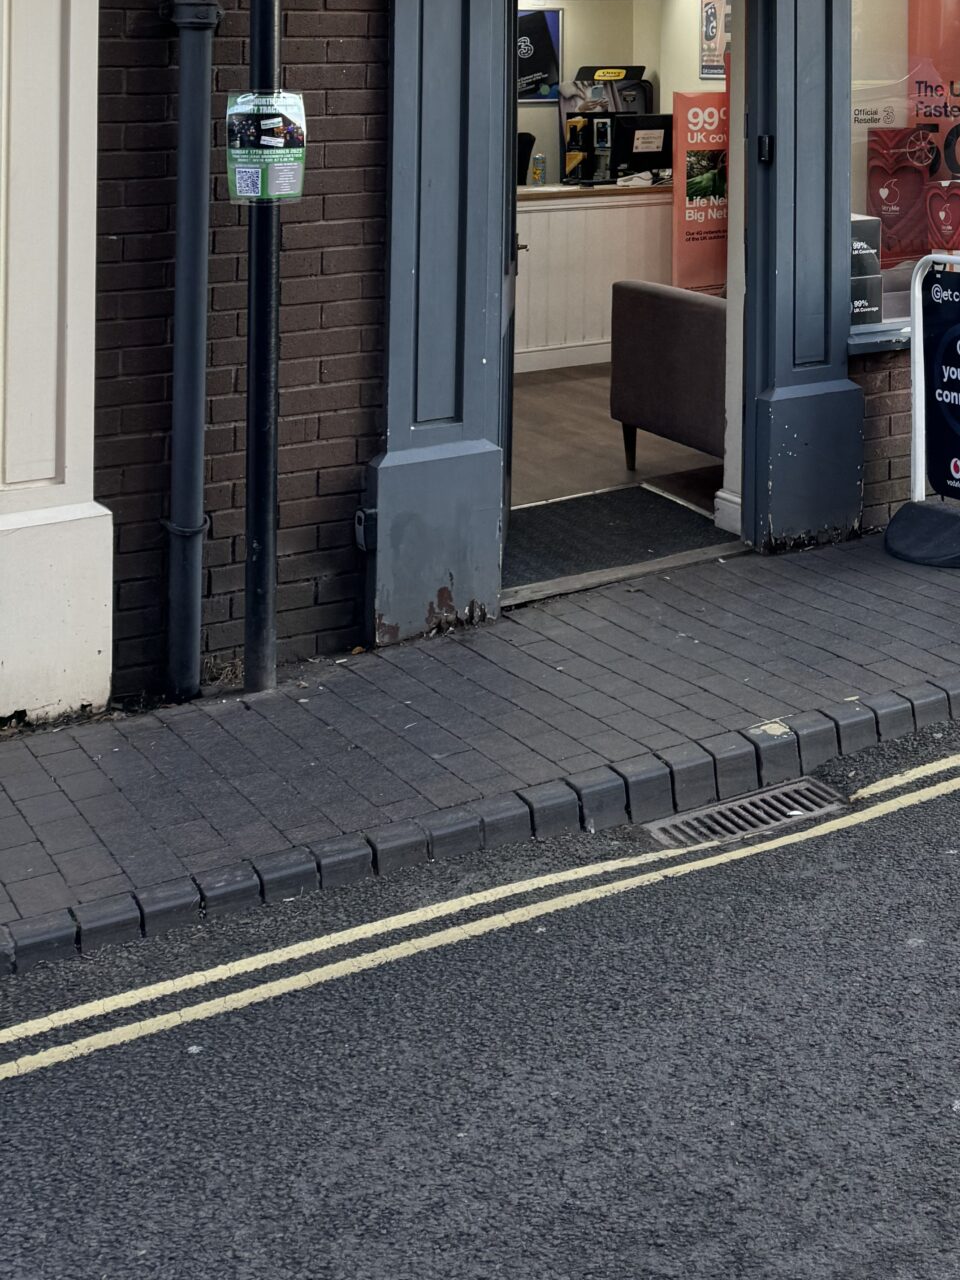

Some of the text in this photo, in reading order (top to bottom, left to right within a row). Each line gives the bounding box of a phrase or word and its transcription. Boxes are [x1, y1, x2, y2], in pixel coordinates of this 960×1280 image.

[915, 80, 944, 97] The
[853, 108, 879, 116] Official
[688, 132, 707, 143] UK
[686, 196, 710, 208] Life
[686, 209, 705, 222] Big
[933, 286, 953, 302] Get
